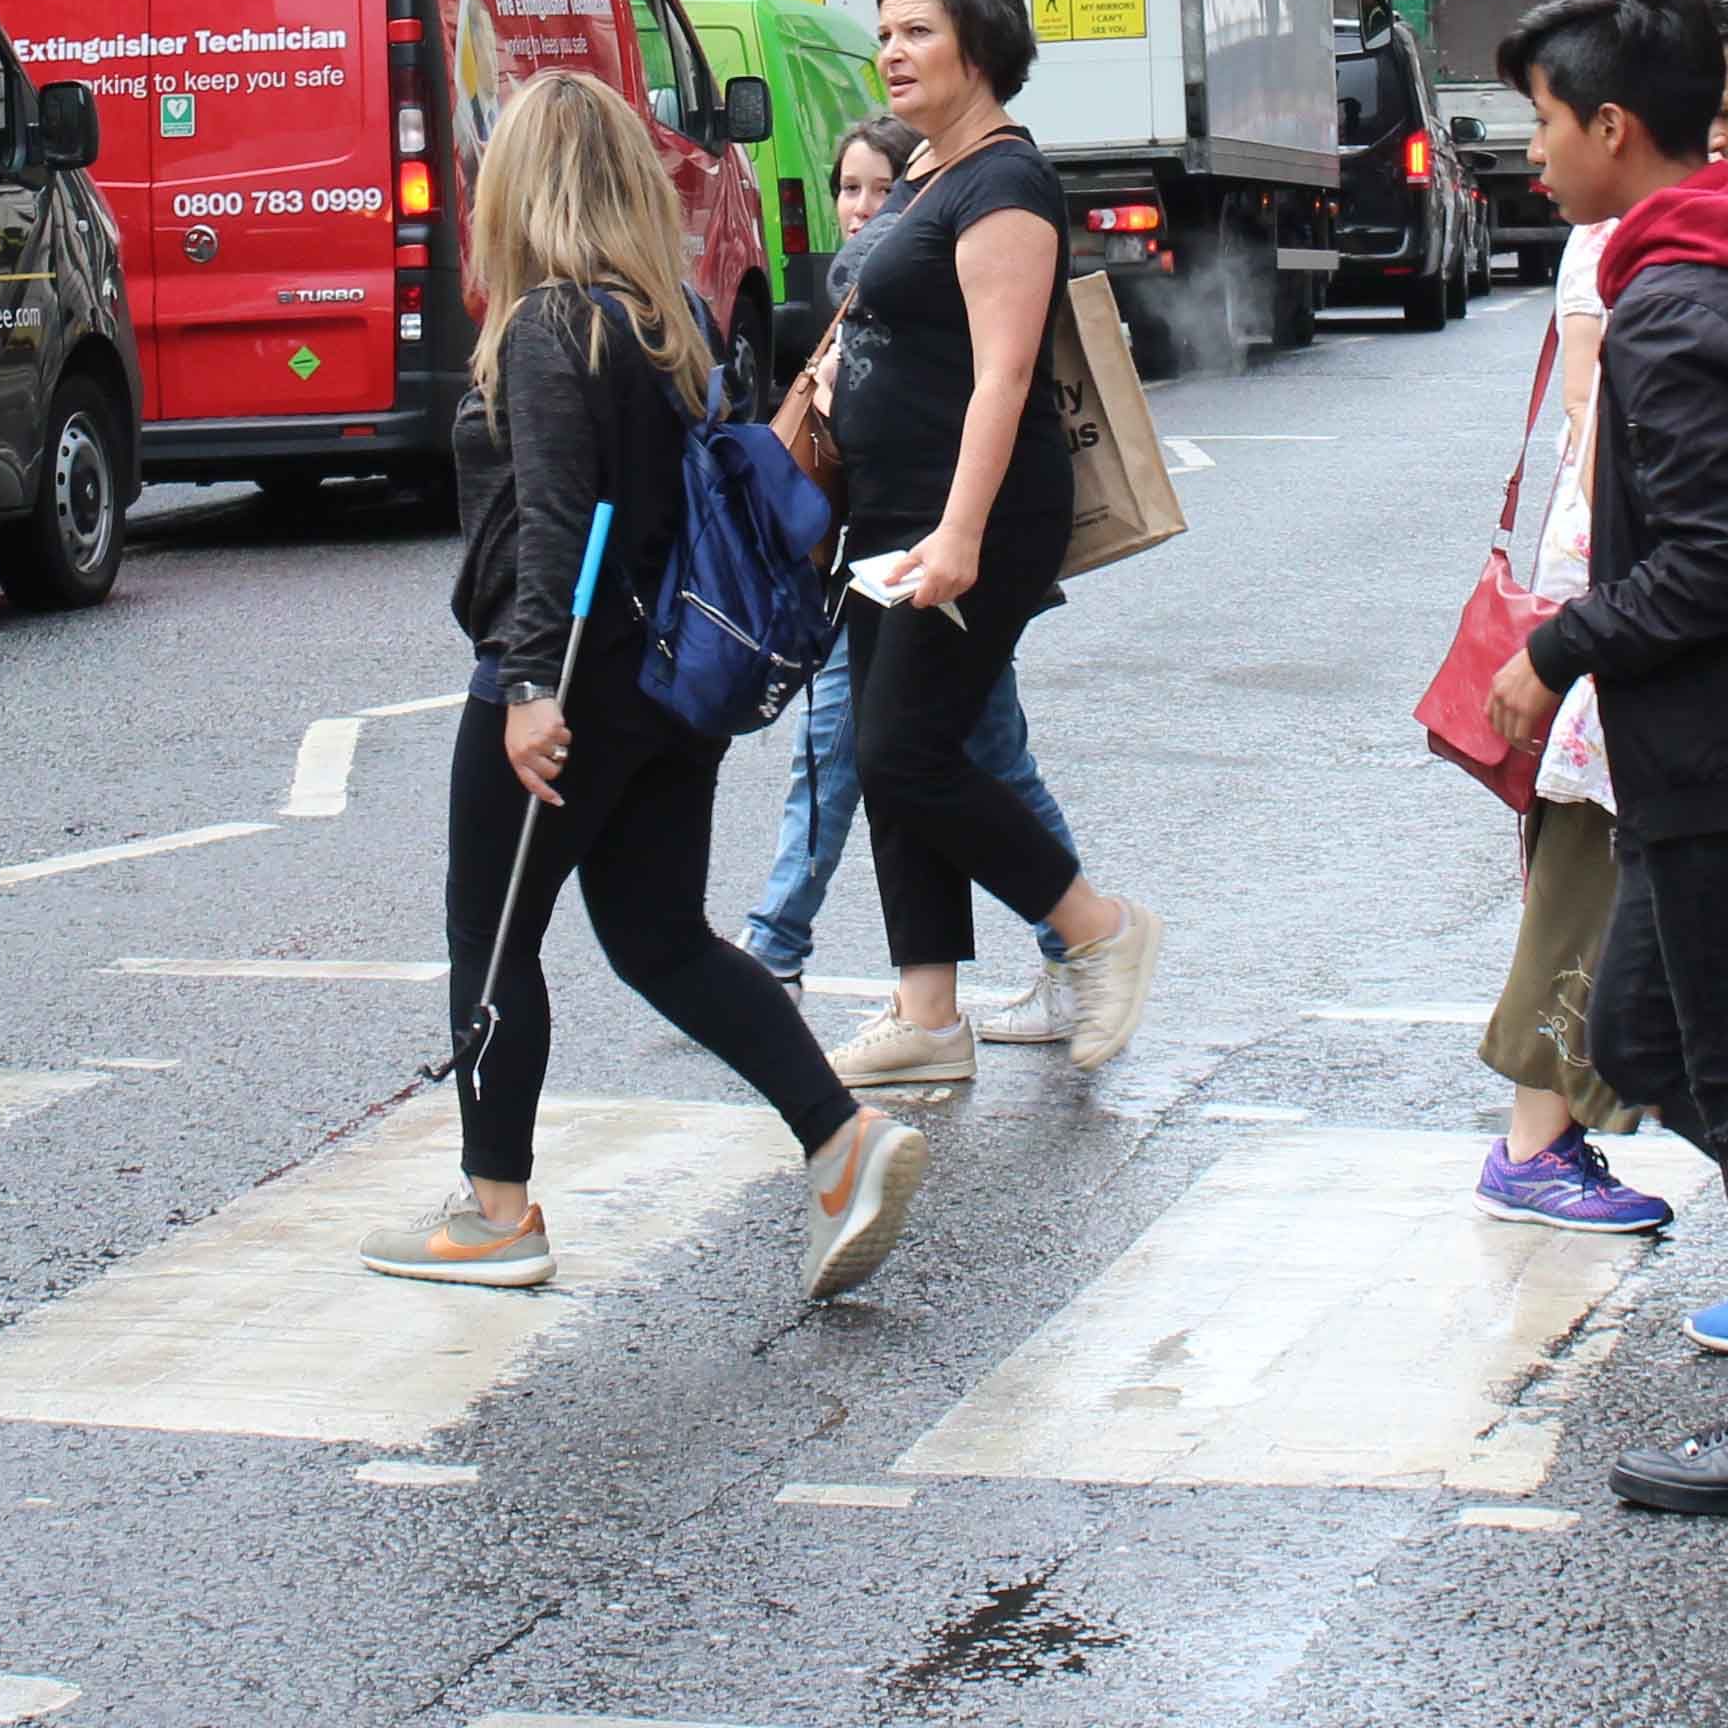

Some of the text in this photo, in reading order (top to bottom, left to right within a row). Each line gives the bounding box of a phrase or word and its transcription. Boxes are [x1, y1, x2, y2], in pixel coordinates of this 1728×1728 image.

[13, 26, 346, 64] Extinguisher Technician
[153, 73, 177, 93] to
[184, 71, 239, 94] keep
[246, 72, 286, 94] you
[294, 65, 345, 87] safe
[173, 187, 382, 217] 0800 783 0999
